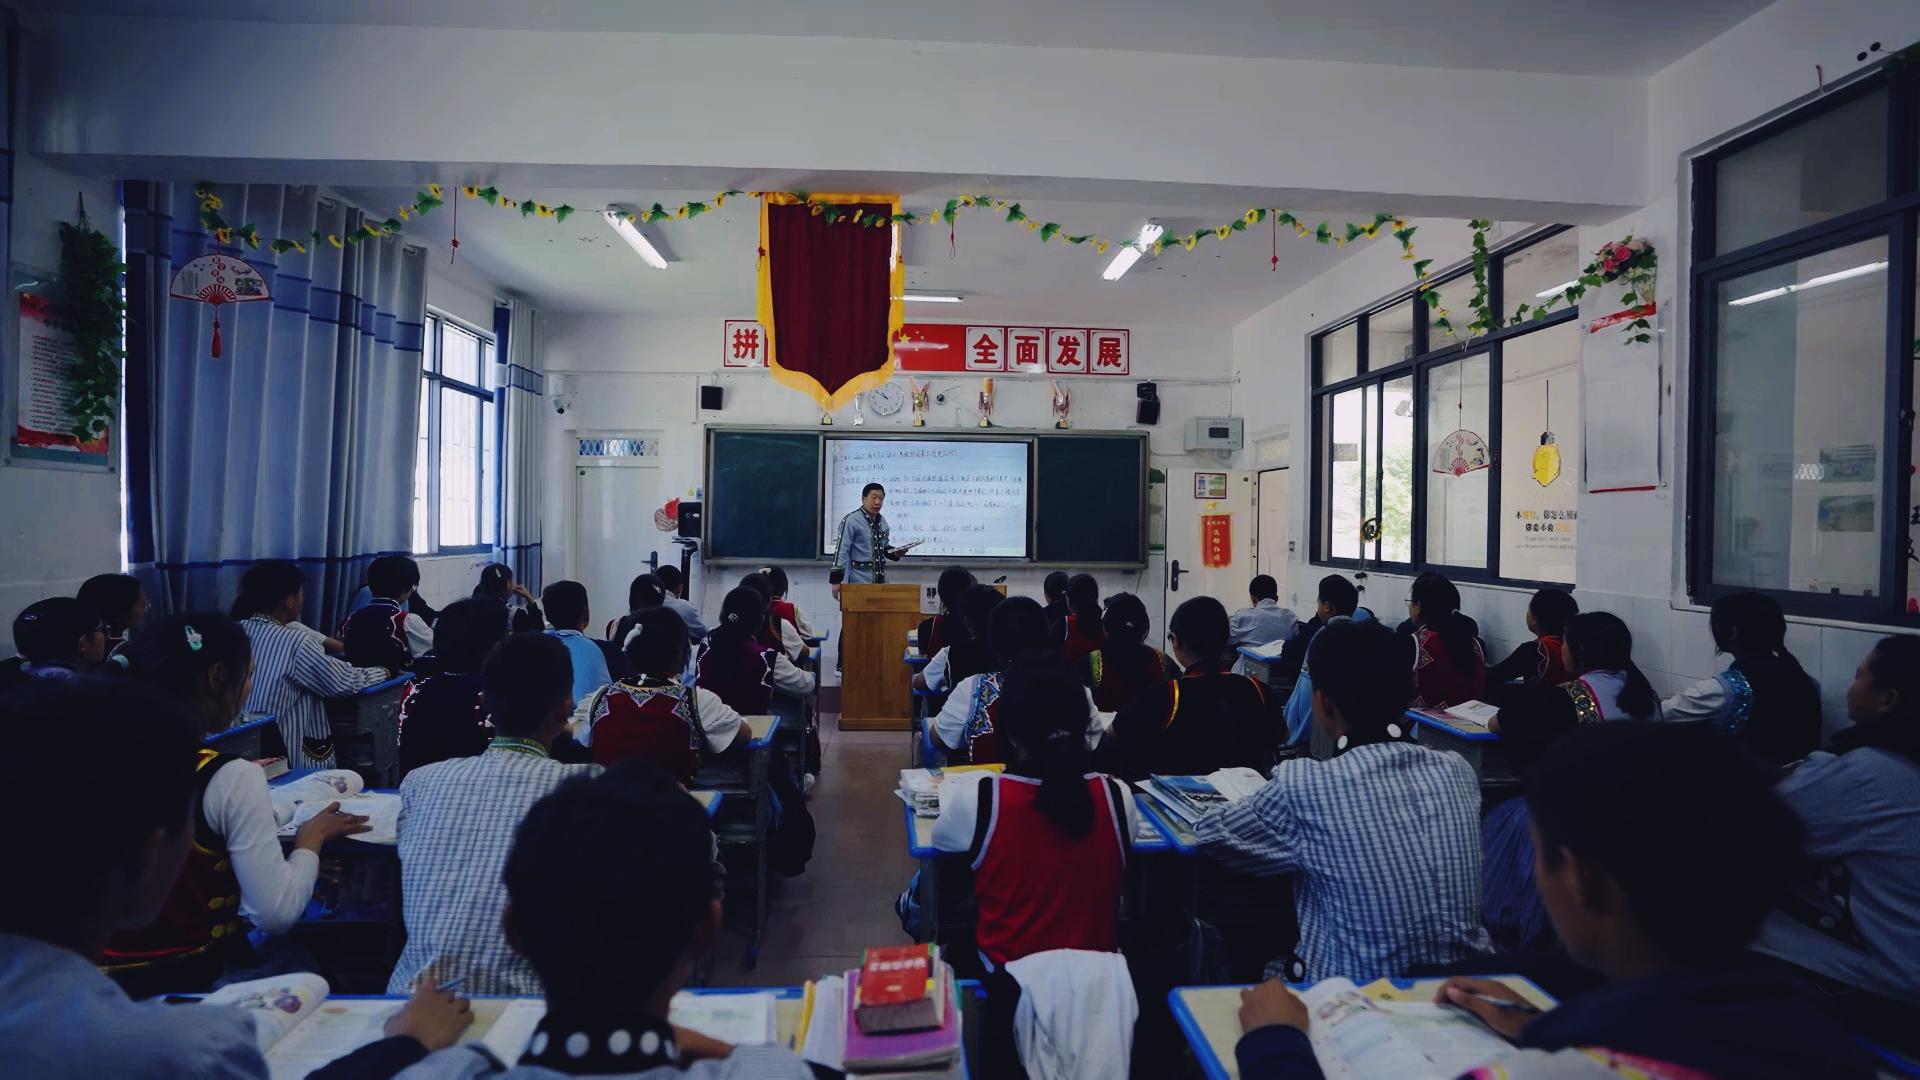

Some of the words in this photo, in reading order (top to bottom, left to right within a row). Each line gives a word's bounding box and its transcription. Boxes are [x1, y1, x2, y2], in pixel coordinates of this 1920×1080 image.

[732, 328, 759, 359] 拼
[973, 333, 1122, 367] 全面发展
